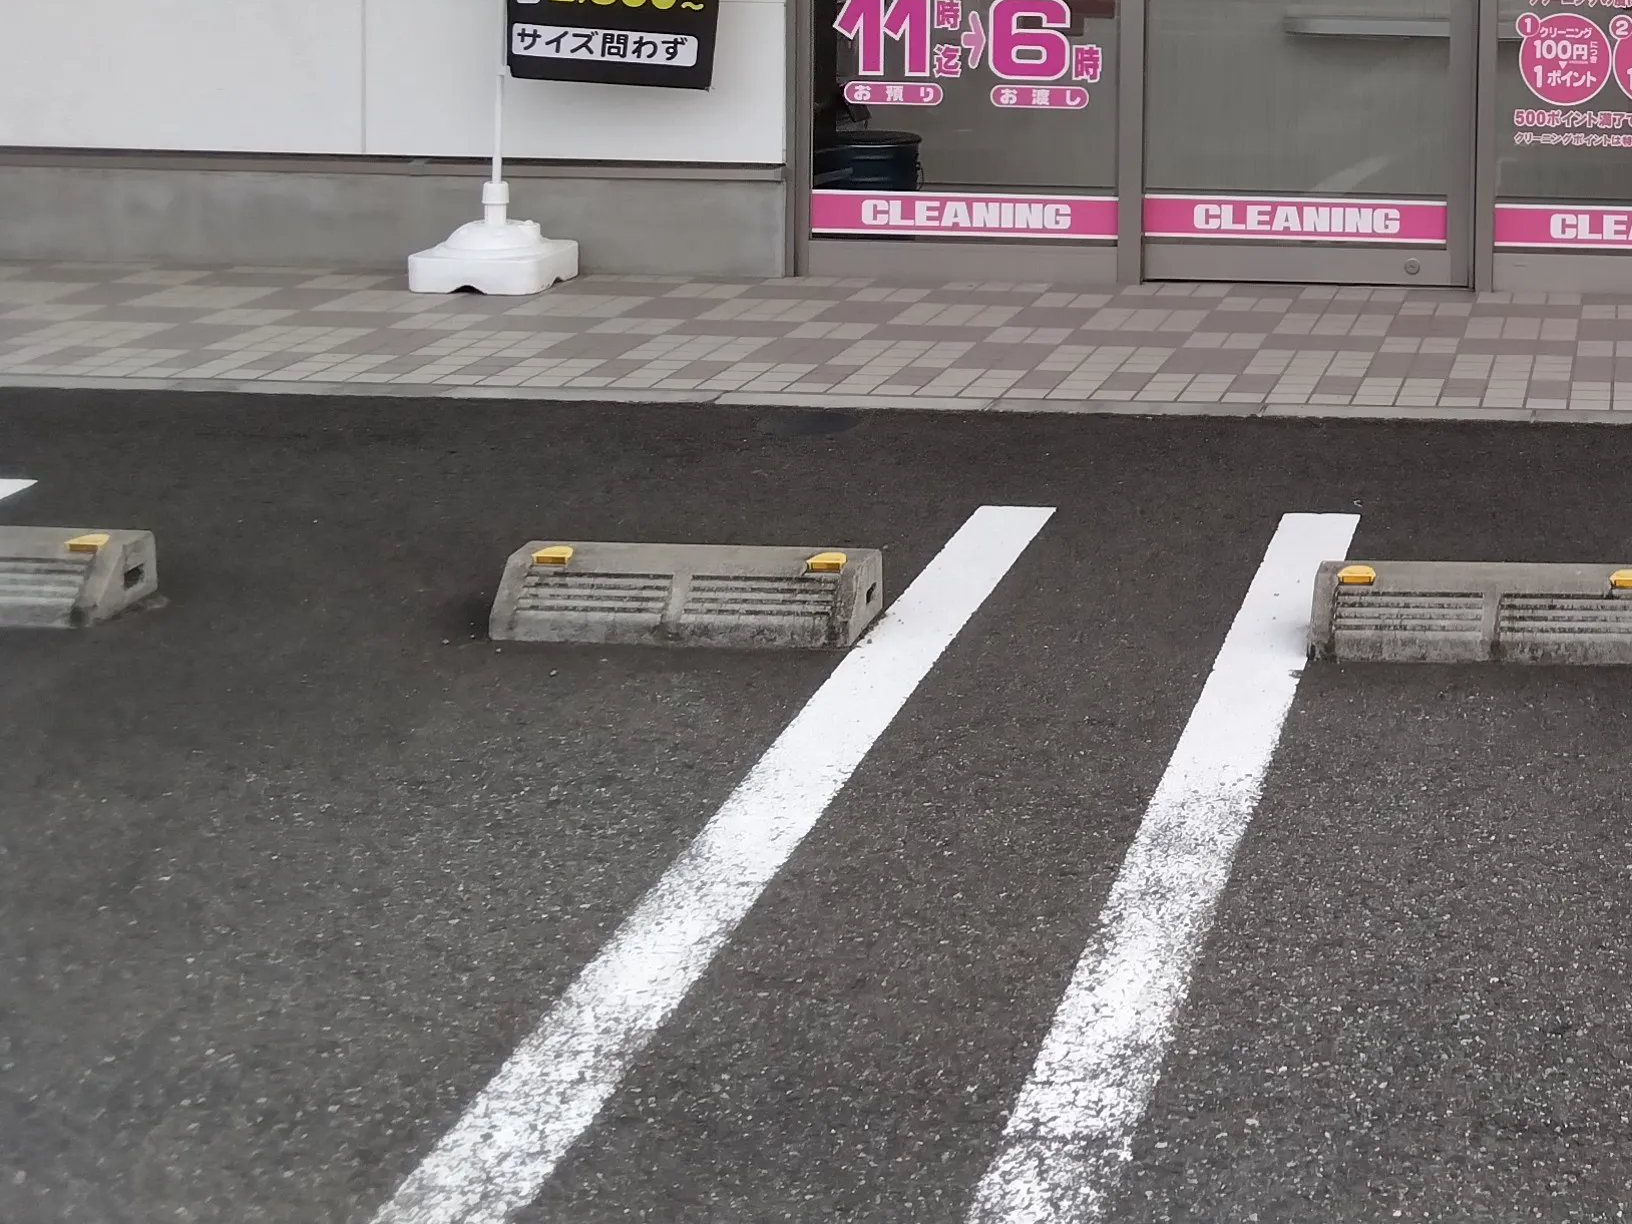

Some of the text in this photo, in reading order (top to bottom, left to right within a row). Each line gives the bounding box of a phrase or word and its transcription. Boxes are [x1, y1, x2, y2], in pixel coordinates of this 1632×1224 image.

[516, 27, 690, 61] サイズ問わず
[1540, 26, 1592, 39] クリーニング
[860, 197, 1072, 231] CLEANING
[1193, 201, 1401, 235] CLEANING
